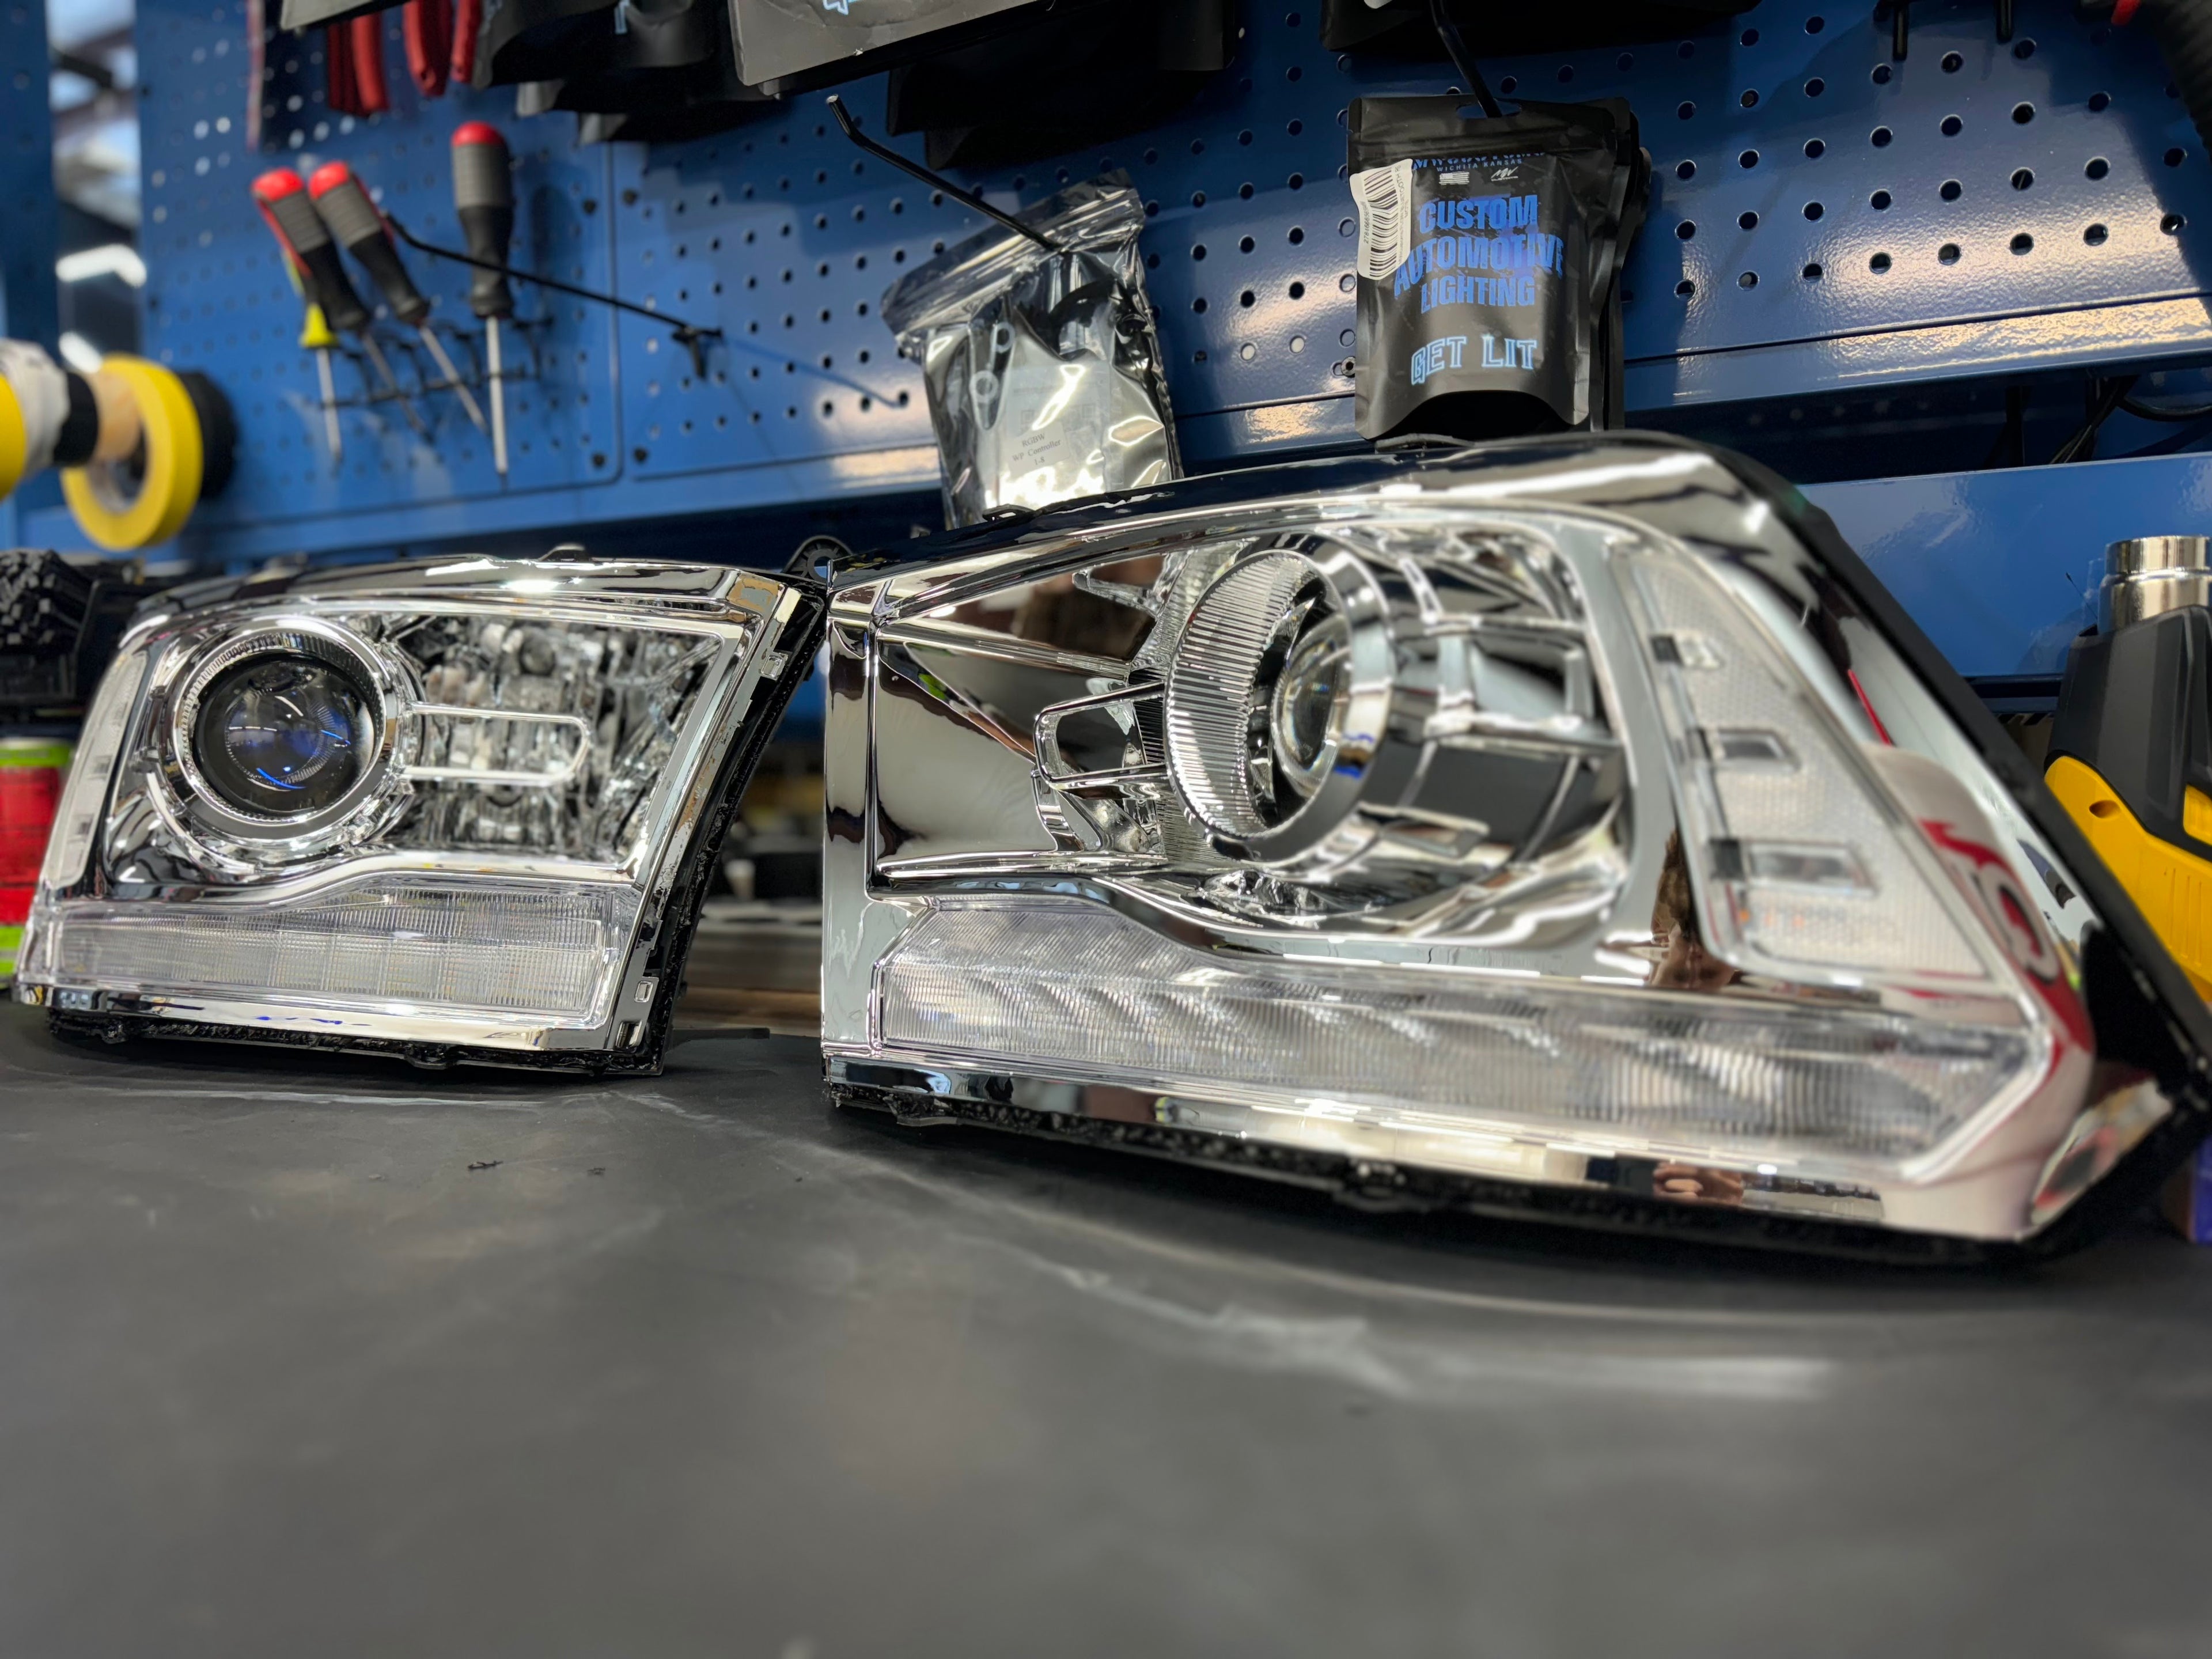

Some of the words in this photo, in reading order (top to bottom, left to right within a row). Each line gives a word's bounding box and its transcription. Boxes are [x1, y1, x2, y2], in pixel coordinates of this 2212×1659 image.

[1437, 163, 1478, 172] WICHITA
[1484, 158, 1522, 168] KANSAS
[1419, 194, 1538, 234] CUSTOM
[1394, 232, 1565, 298] AUTOMOTIVE
[1421, 275, 1535, 314] LIGHTING
[1411, 336, 1468, 386] GET
[1480, 334, 1537, 370] LIT
[1012, 452, 1024, 461] WP
[1028, 439, 1061, 456] Controller
[1021, 433, 1046, 447] RGBW
[1034, 456, 1046, 465] 1-8
